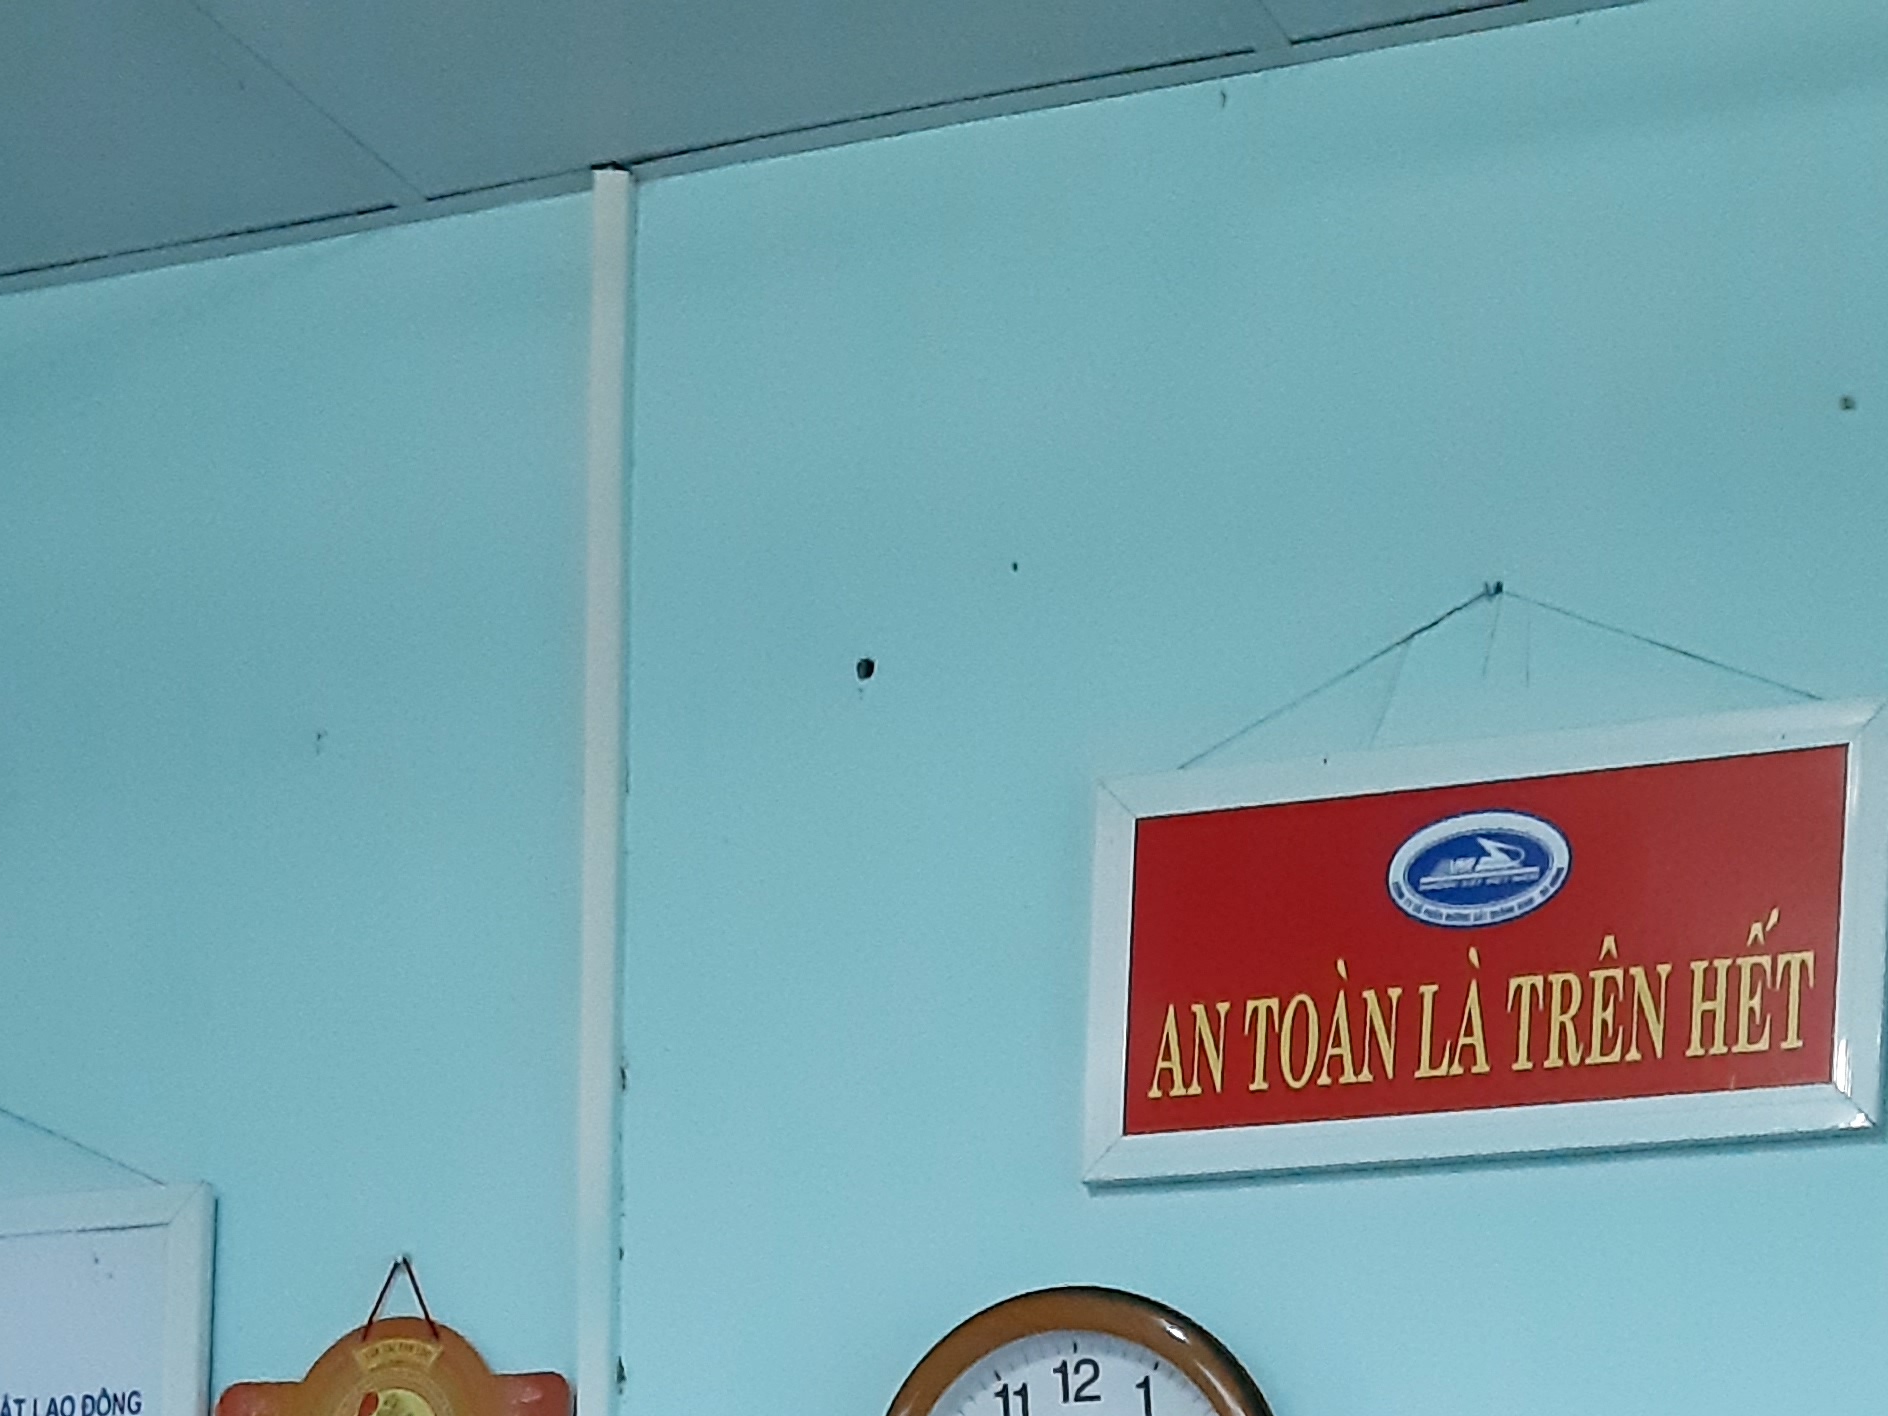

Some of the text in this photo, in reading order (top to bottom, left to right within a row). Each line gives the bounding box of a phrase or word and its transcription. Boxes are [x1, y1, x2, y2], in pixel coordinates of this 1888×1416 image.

[1147, 906, 1815, 1098] AN TOÀN LÀ TRÊN HẾT
[1052, 1358, 1101, 1404] 12
